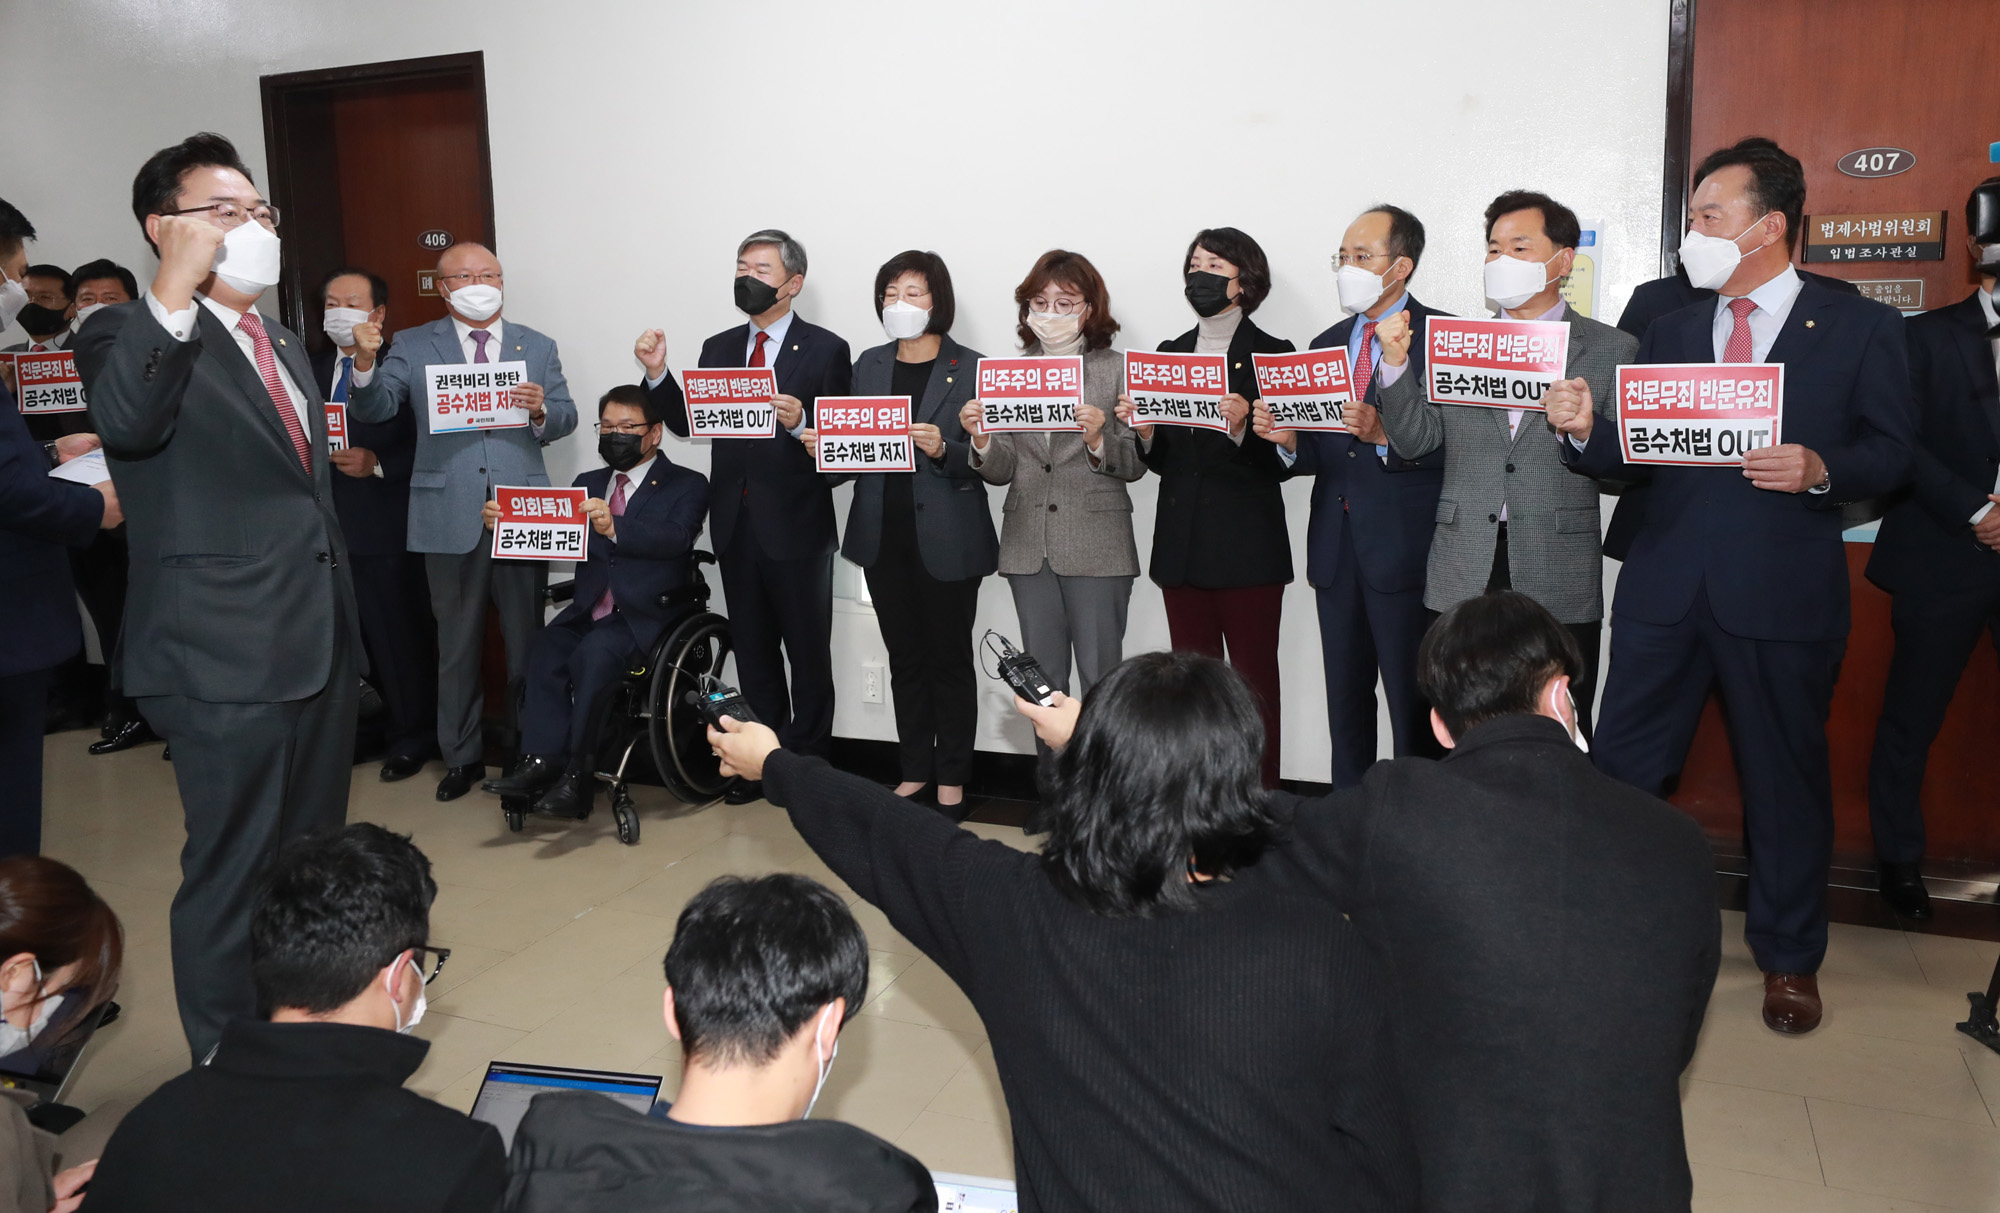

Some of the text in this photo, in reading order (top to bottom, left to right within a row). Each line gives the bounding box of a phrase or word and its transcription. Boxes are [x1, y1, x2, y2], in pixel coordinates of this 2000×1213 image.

[1854, 153, 1900, 171] 407
[1820, 218, 1932, 239] 법제사법위원회
[425, 233, 446, 246] 406
[1830, 246, 1918, 260] 입법조사관실
[1874, 284, 1903, 295] 출입을
[1433, 330, 1561, 364] 친문무죄 반문유죄
[20, 360, 63, 381] 친문무죄
[435, 371, 520, 390] 권력비리 방탄
[981, 367, 1078, 392] 민주주의 유린
[1129, 361, 1222, 389] 민주주의 유린
[1257, 359, 1347, 390] 민주주의 유린
[686, 377, 772, 399] 친문무죄 반문유죄
[1435, 371, 1508, 399] 공수처법
[1625, 378, 1773, 411] 친문무죄 반문유죄
[24, 387, 78, 408] 공수처법
[437, 391, 492, 415] 공수처법
[1134, 397, 1193, 418] 공수처법
[327, 411, 342, 432] 린
[693, 408, 773, 429] 공수처법 OUT
[819, 407, 906, 430] 민주주의 유린
[985, 403, 1077, 424] 공수처법 저지
[1268, 401, 1323, 422] 공수처법
[823, 441, 907, 463] 공수처법 저지
[1630, 427, 1769, 456] 공수처법 OUT
[510, 496, 574, 518] 의회독재
[501, 528, 581, 552] 공수처법 규탄
